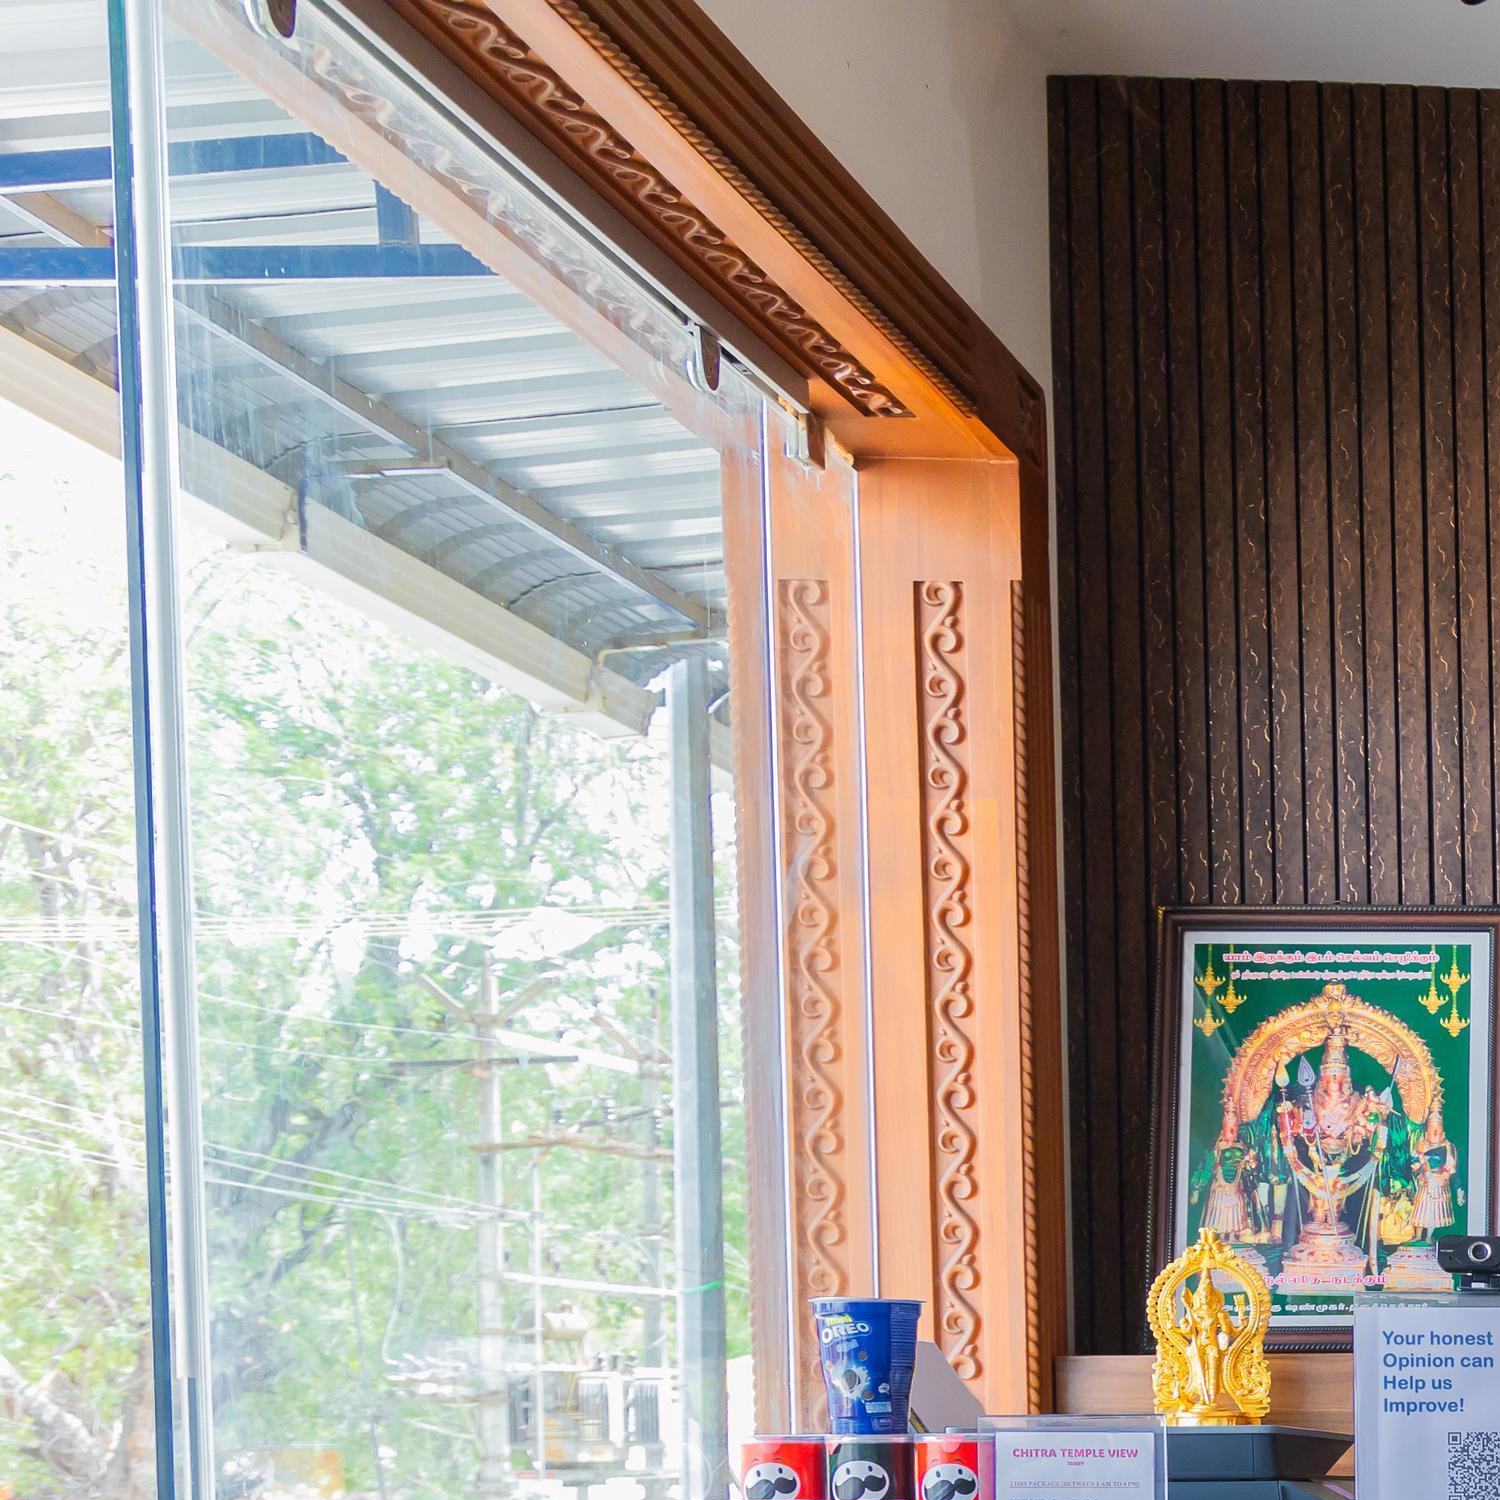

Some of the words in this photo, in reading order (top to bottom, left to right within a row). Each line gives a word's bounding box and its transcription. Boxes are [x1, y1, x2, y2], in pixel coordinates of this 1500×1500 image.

[822, 1322, 870, 1344] OREO
[1382, 1330, 1425, 1345] Your
[1430, 1330, 1494, 1345] honest
[1383, 1353, 1455, 1371] Opinion
[1460, 1356, 1494, 1368] can
[1383, 1375, 1426, 1393] Help
[1431, 1379, 1453, 1390] us
[1384, 1397, 1464, 1416] Improve!
[1013, 1448, 1056, 1458] CHITRA
[1060, 1448, 1105, 1458] TEMPLE
[1107, 1448, 1138, 1458] VIEW
